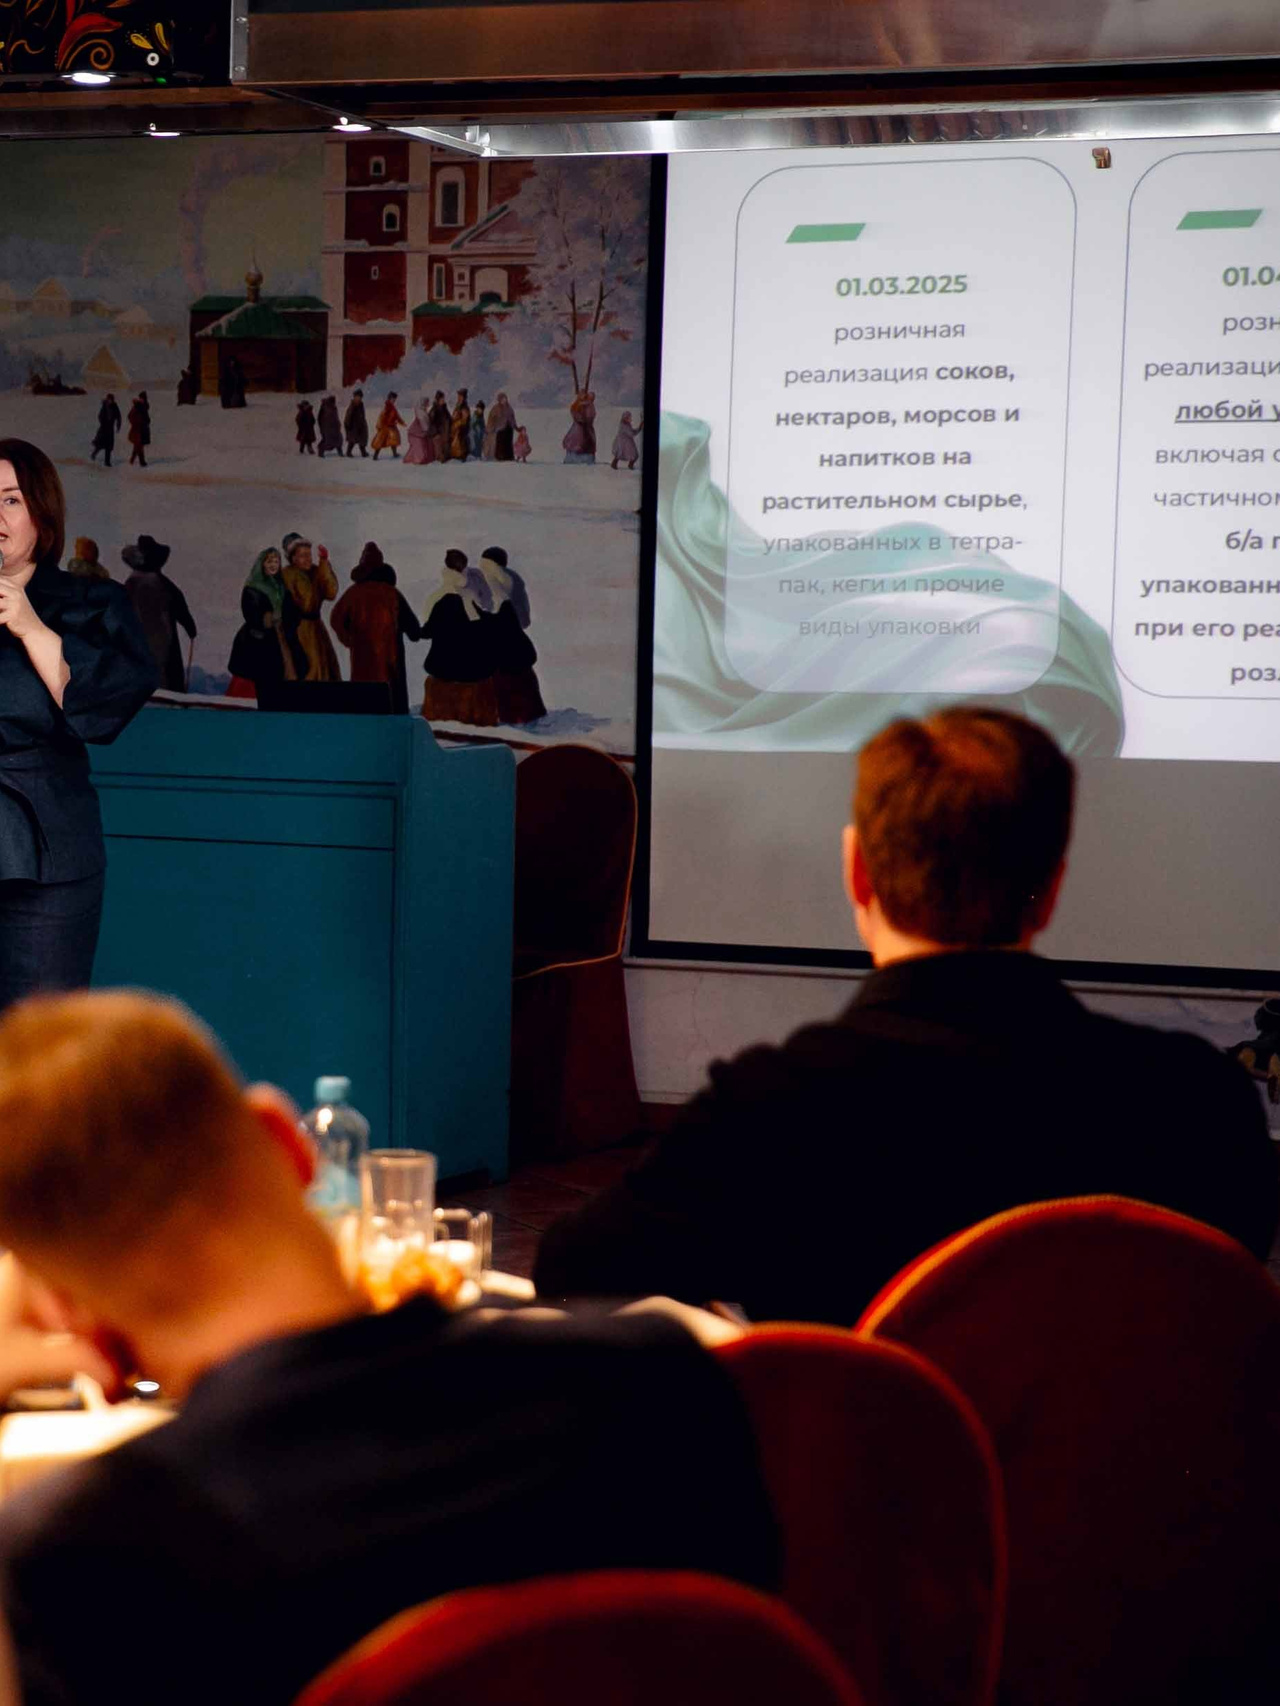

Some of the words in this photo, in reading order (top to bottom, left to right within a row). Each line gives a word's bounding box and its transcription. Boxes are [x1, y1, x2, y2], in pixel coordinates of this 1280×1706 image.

[835, 274, 968, 297] 01.03.2025
[834, 323, 966, 345] розничная
[784, 366, 929, 388] реализация
[935, 365, 1015, 382] соков,
[775, 410, 897, 429] нектаров,
[903, 408, 996, 428] морсов
[1004, 408, 1020, 422] и
[1173, 399, 1264, 423] любой
[819, 451, 936, 468] напитков
[943, 451, 972, 465] на
[1155, 448, 1265, 464] включая
[762, 494, 937, 515] растительном
[943, 493, 1027, 512] сырье,
[763, 536, 922, 555] упакованных
[928, 536, 942, 551] в
[949, 535, 1023, 555] тетра-
[1225, 528, 1264, 552] б/а
[778, 579, 826, 596] пак,
[832, 578, 888, 594] кеги
[892, 579, 907, 592] и
[912, 576, 1005, 595] прочие
[799, 620, 860, 638] виды
[866, 620, 981, 639] упаковки
[1134, 622, 1184, 641] при
[1192, 622, 1236, 638] его
[1230, 667, 1280, 685] роз
